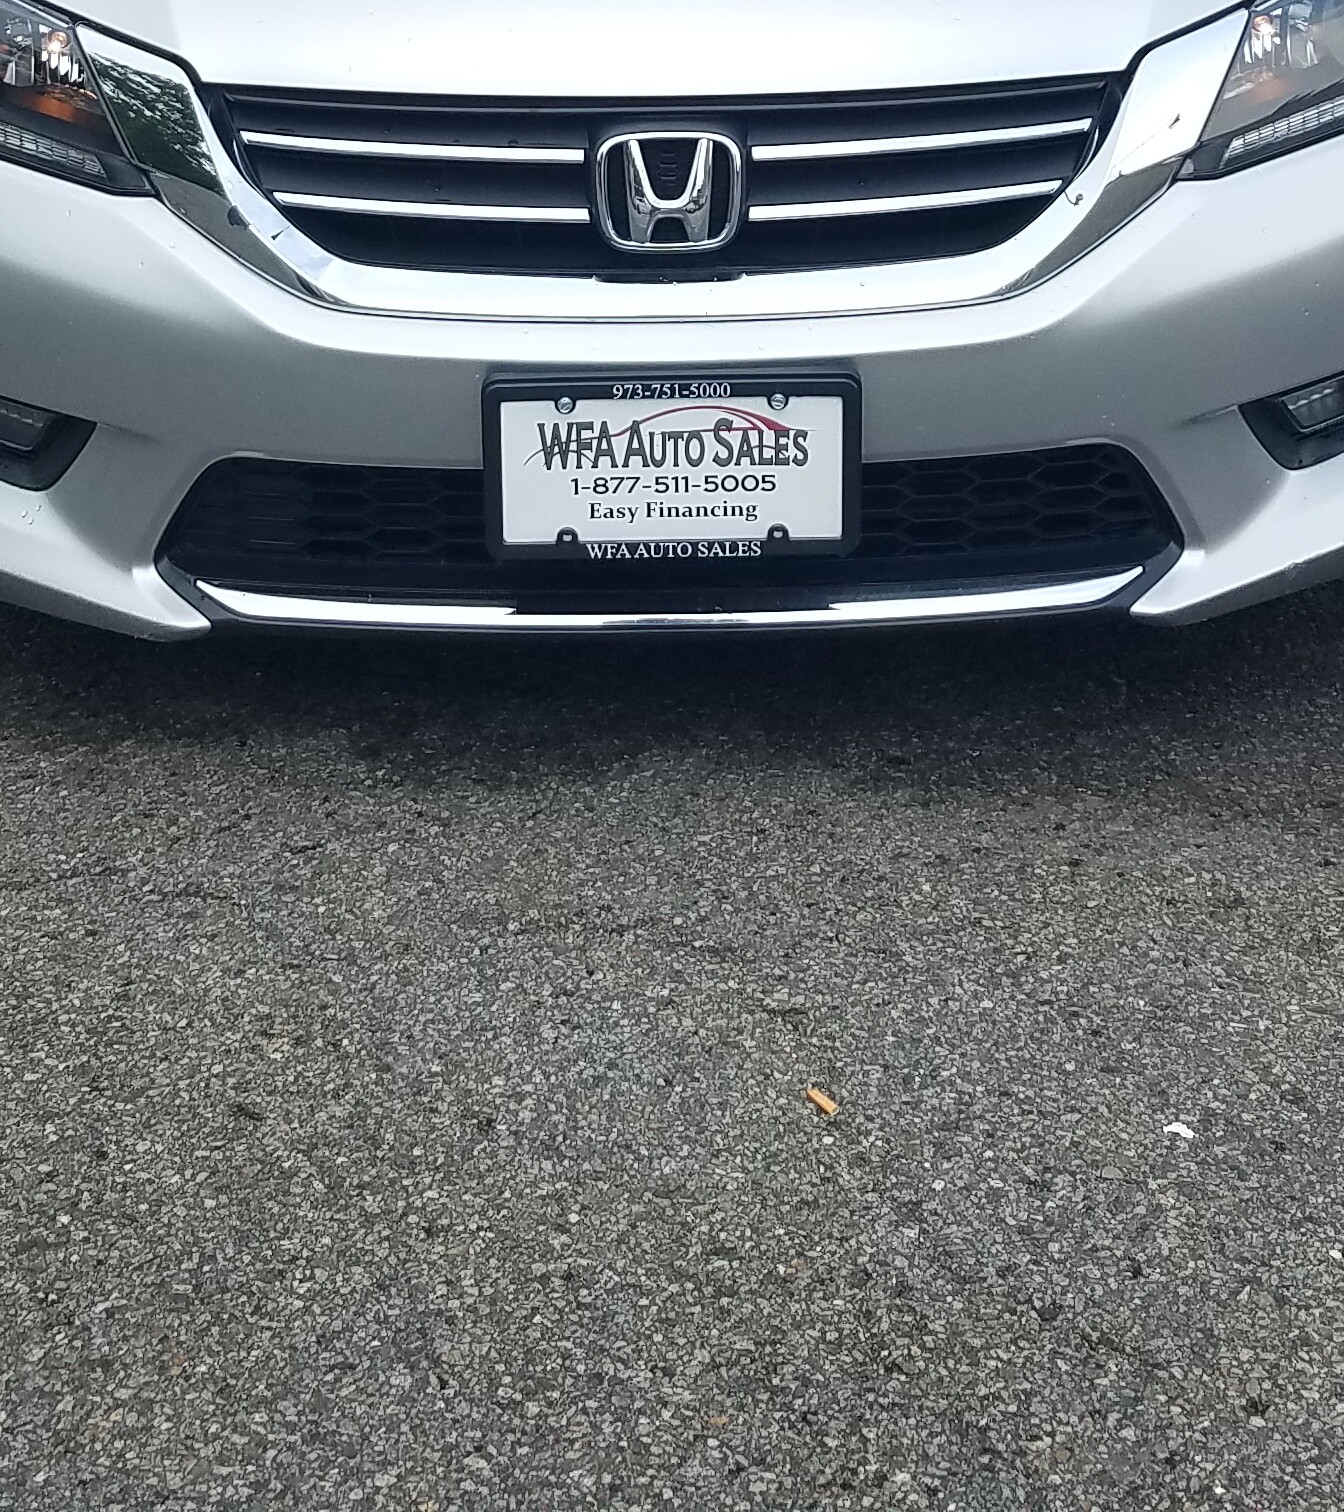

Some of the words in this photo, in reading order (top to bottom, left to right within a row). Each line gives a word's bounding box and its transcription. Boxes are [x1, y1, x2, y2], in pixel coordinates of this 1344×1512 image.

[612, 382, 731, 400] 973-751-5000
[537, 420, 619, 470] WFA
[621, 420, 706, 468] AUTO
[712, 417, 809, 467] SALES
[570, 474, 777, 496] 1-877-511-5005
[588, 502, 640, 524] Easy
[645, 500, 759, 522] Financing
[586, 542, 632, 559] WFA
[634, 541, 693, 558] AUTO
[697, 541, 762, 557] SALES
